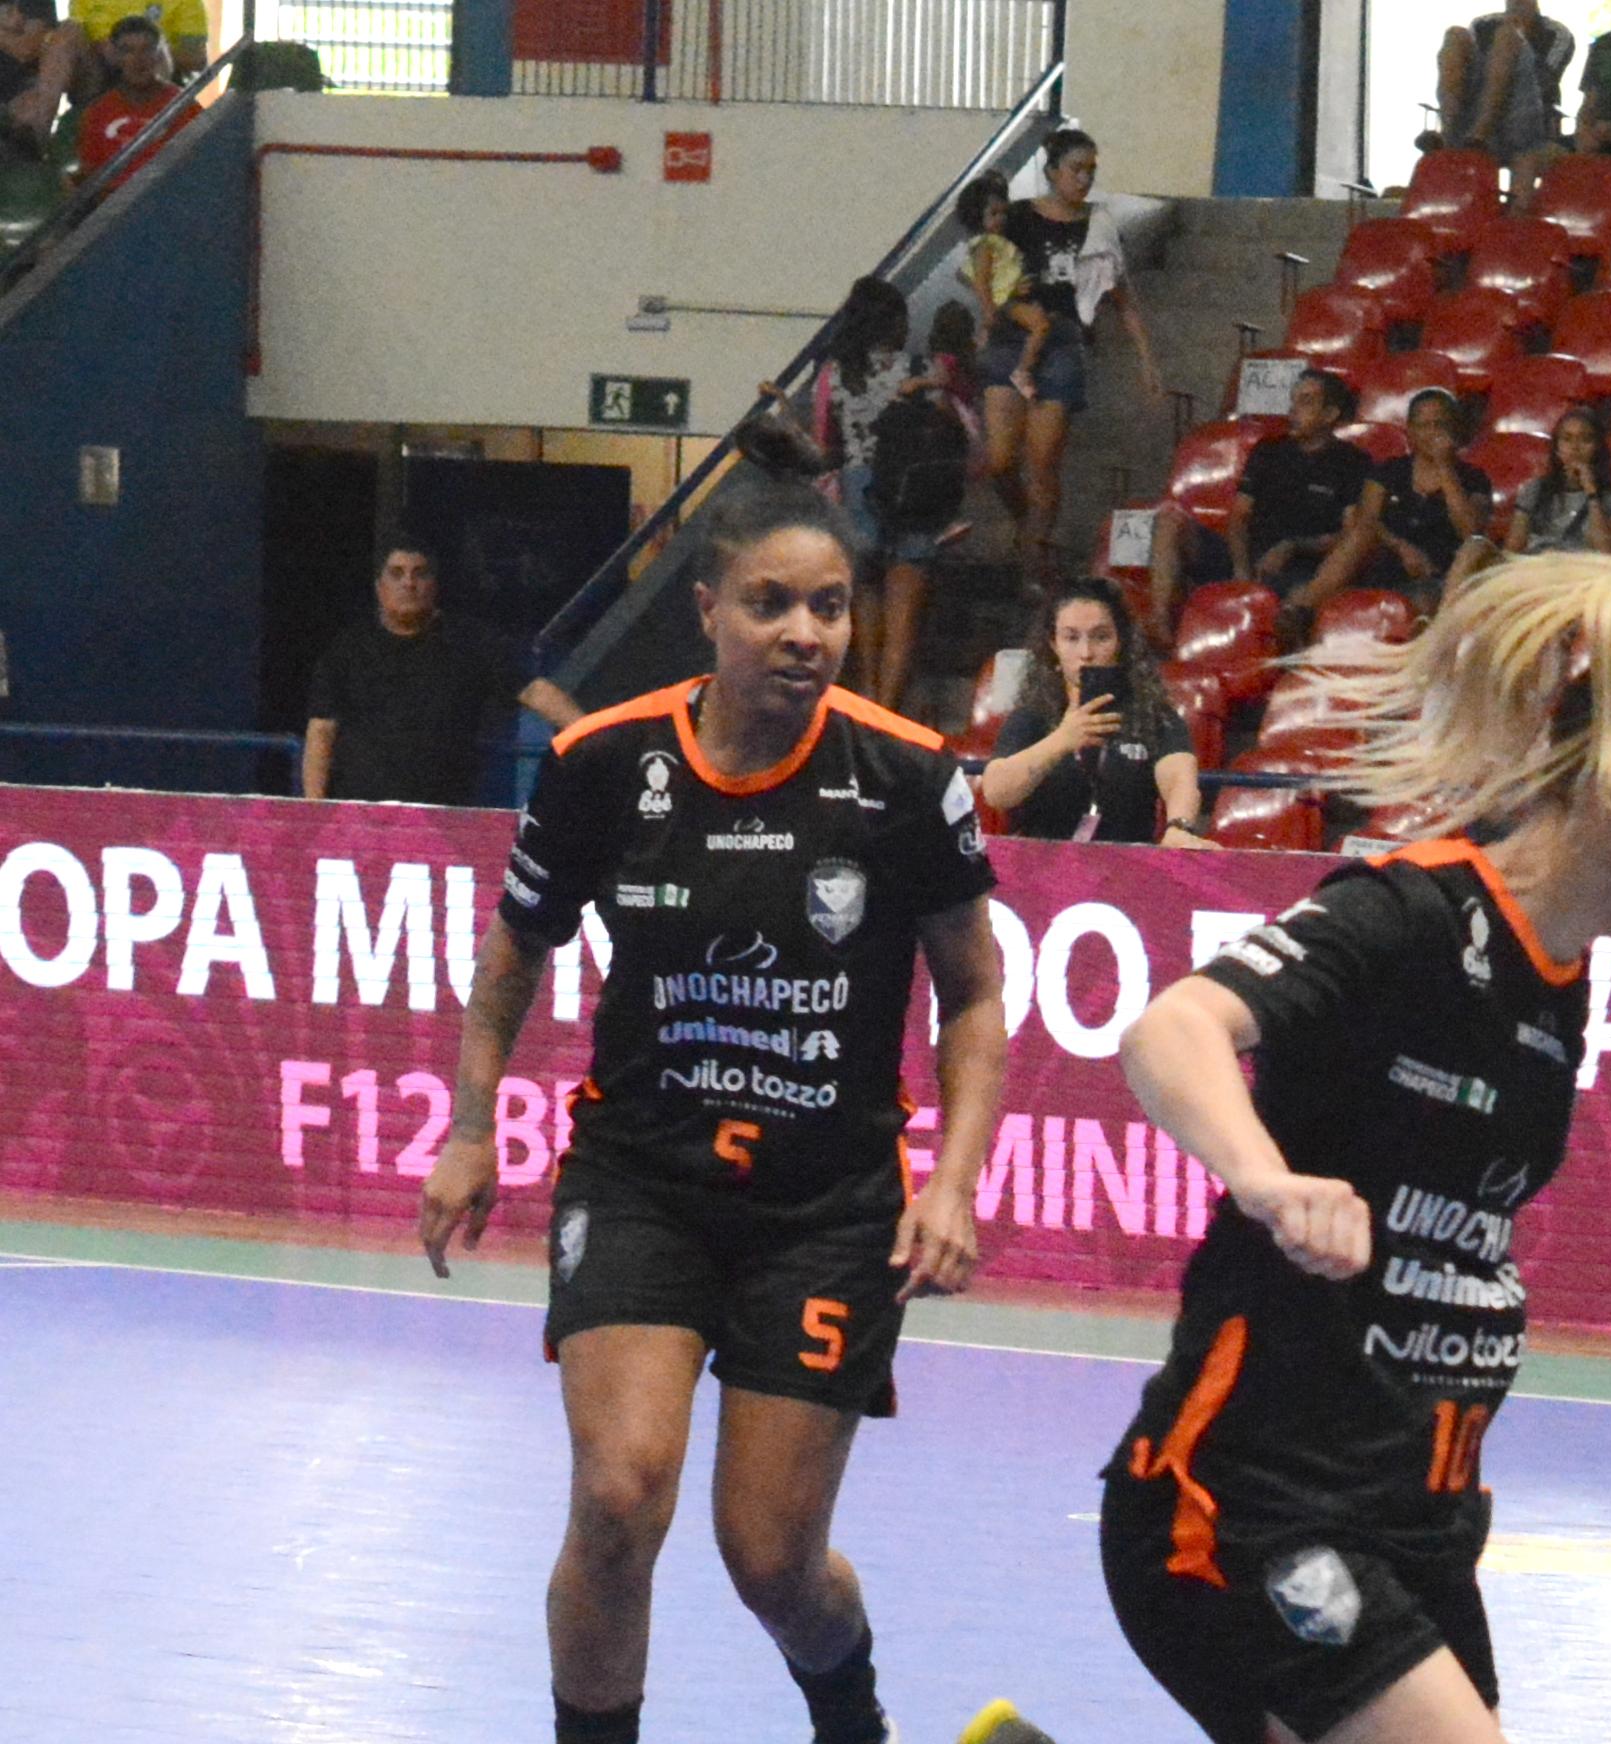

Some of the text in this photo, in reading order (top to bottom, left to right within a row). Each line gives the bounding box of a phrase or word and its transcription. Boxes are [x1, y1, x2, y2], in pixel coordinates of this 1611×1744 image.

[653, 970, 849, 1014] UNOCHAPECÓ
[281, 1060, 452, 1176] F12
[751, 1065, 838, 1109] tozzo
[713, 1119, 764, 1171] 5
[798, 1296, 849, 1373] 5
[1426, 1401, 1490, 1494] 10
